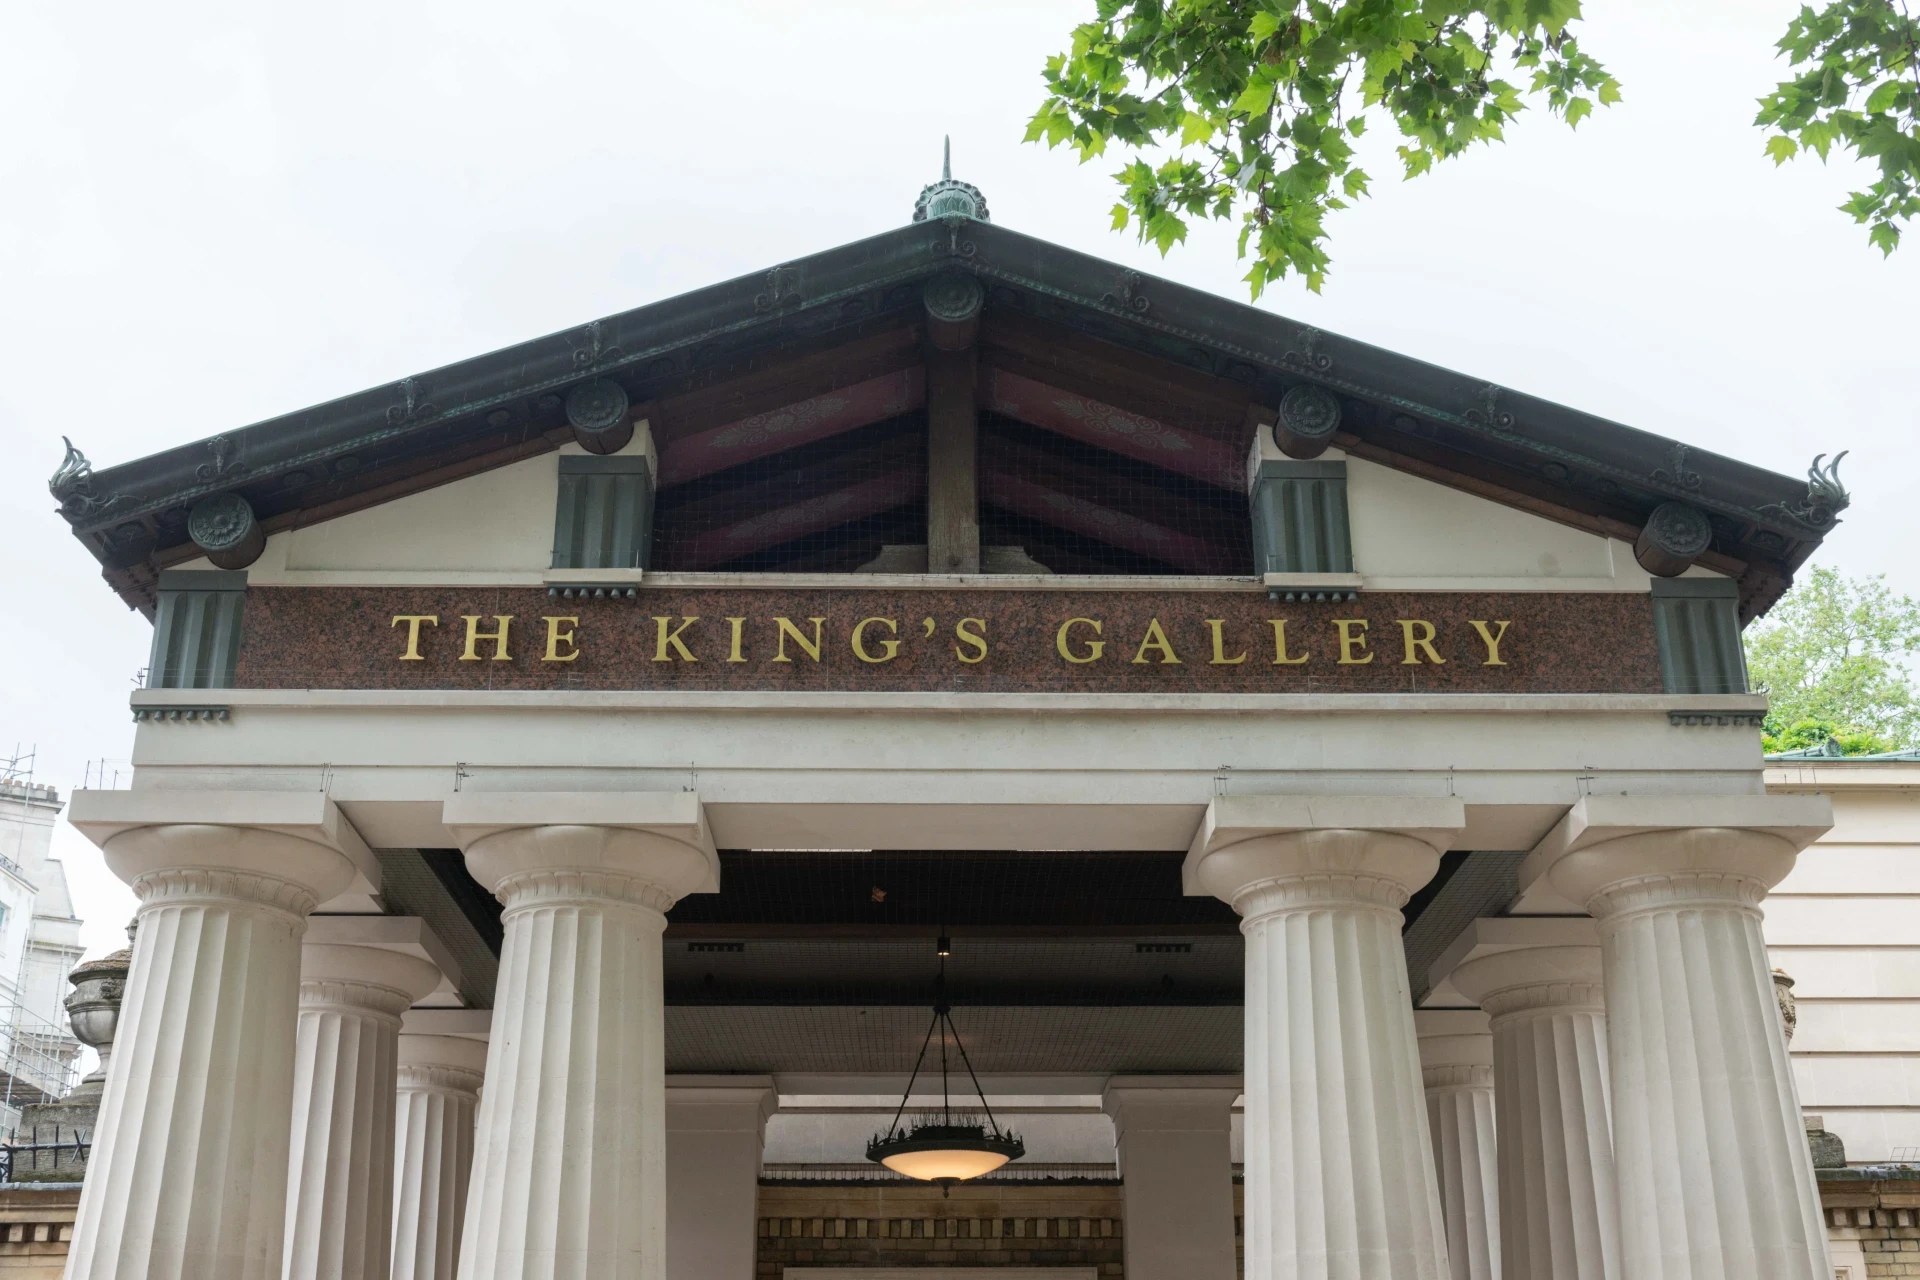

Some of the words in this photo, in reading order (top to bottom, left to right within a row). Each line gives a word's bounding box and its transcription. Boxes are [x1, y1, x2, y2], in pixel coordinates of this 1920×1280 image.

[390, 614, 581, 662] THE
[650, 615, 990, 665] KING'S
[1055, 616, 1512, 667] GALLERY
